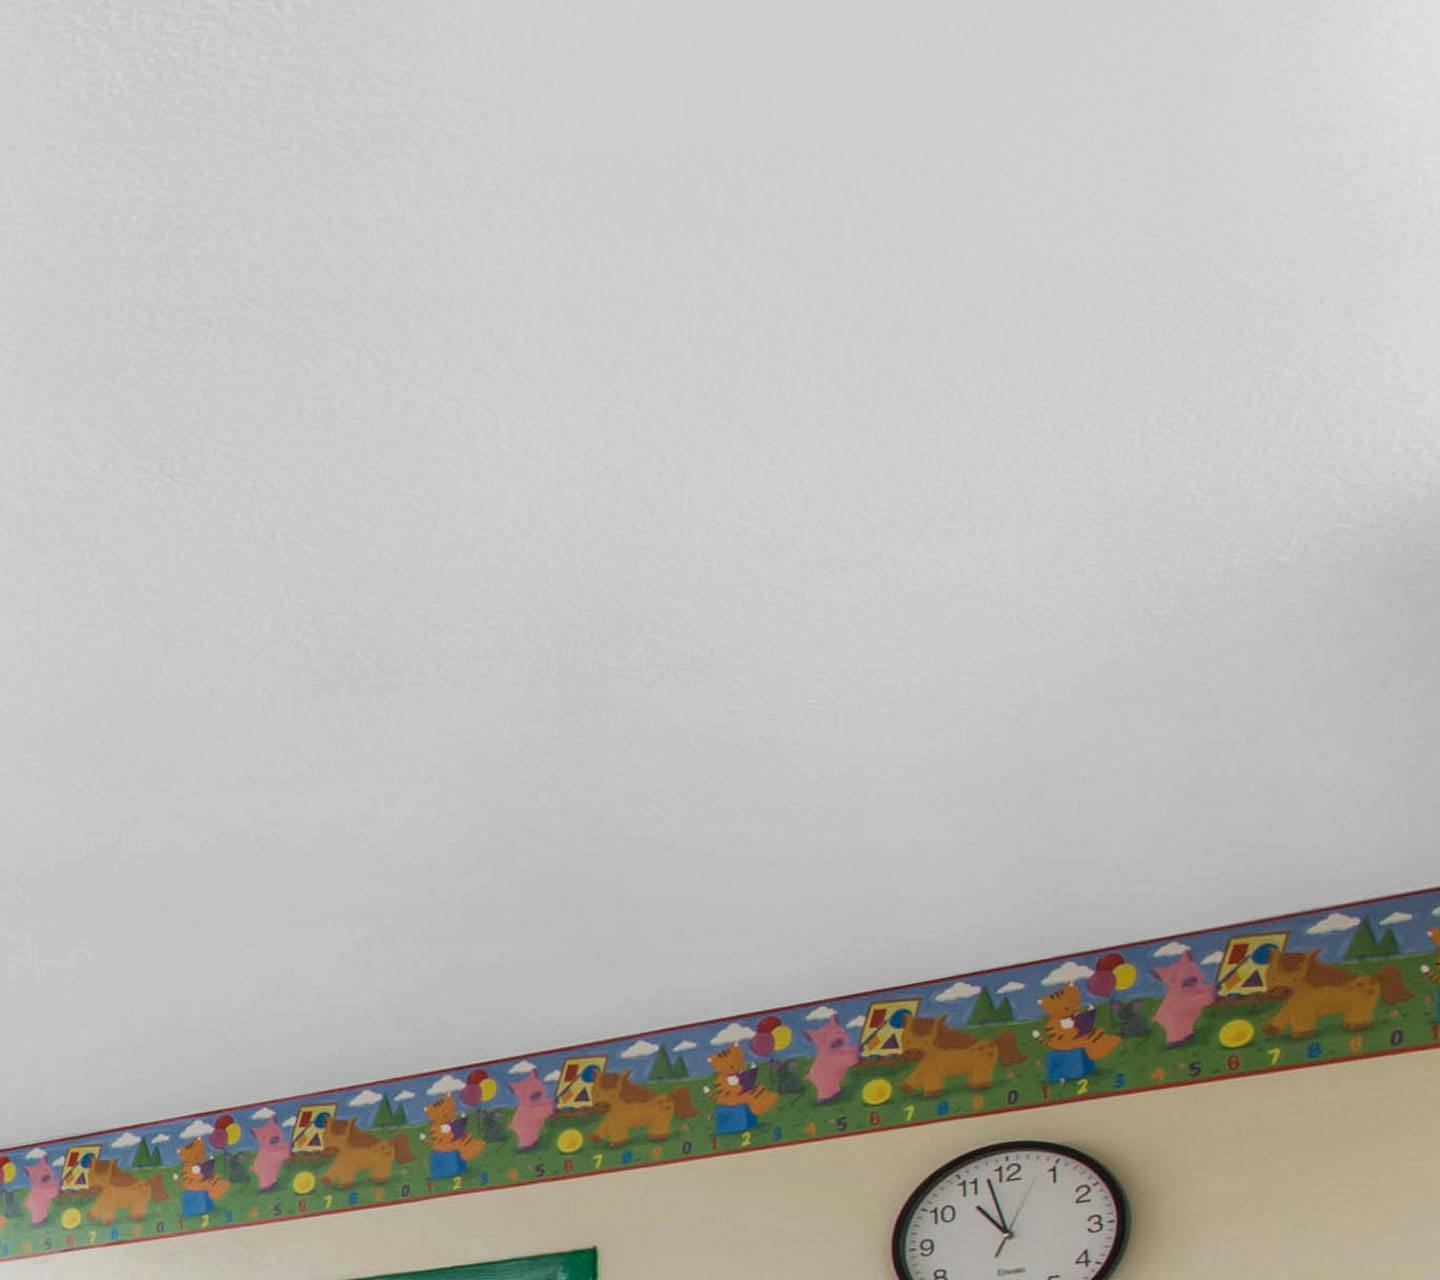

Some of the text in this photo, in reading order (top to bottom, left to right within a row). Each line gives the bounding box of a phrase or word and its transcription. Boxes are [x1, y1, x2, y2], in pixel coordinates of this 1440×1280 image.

[994, 1162, 1022, 1183] 12
[1048, 1165, 1057, 1183] 1
[958, 1177, 978, 1197] 11
[1075, 1184, 1092, 1204] 2
[929, 1204, 956, 1225] 10
[1087, 1214, 1104, 1234] 3
[919, 1238, 935, 1257] 9
[1075, 1249, 1092, 1267] 4
